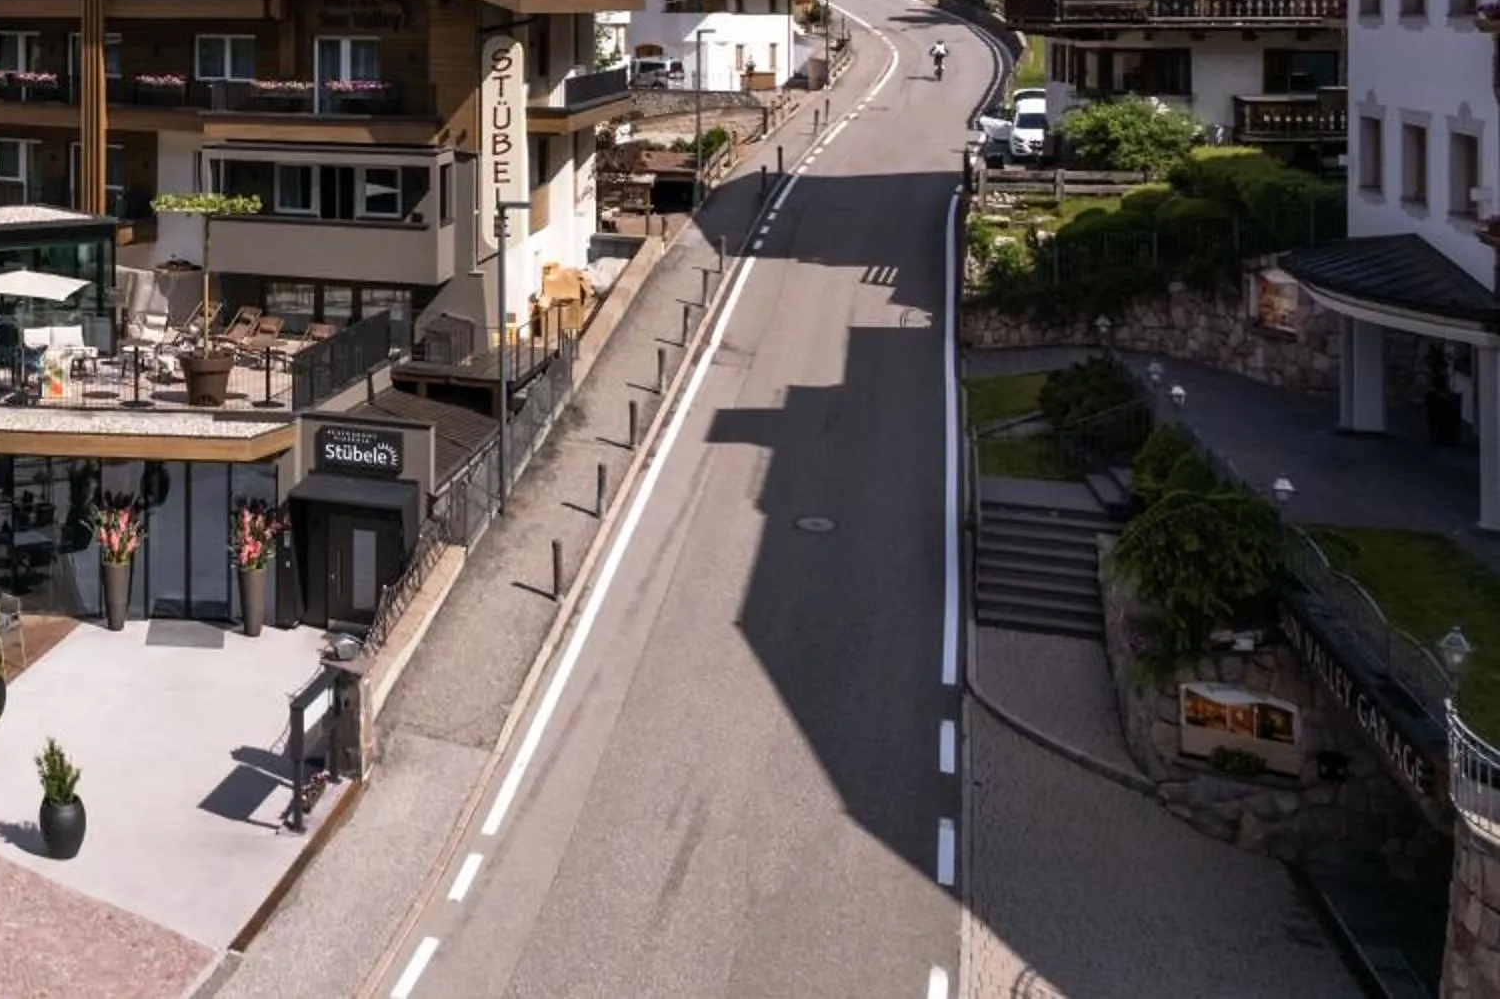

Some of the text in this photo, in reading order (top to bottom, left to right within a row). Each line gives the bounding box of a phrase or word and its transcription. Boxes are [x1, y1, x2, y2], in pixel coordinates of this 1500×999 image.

[325, 442, 388, 466] Stübele
[1304, 629, 1353, 709] VALLEY
[1356, 693, 1426, 796] GARAGE
